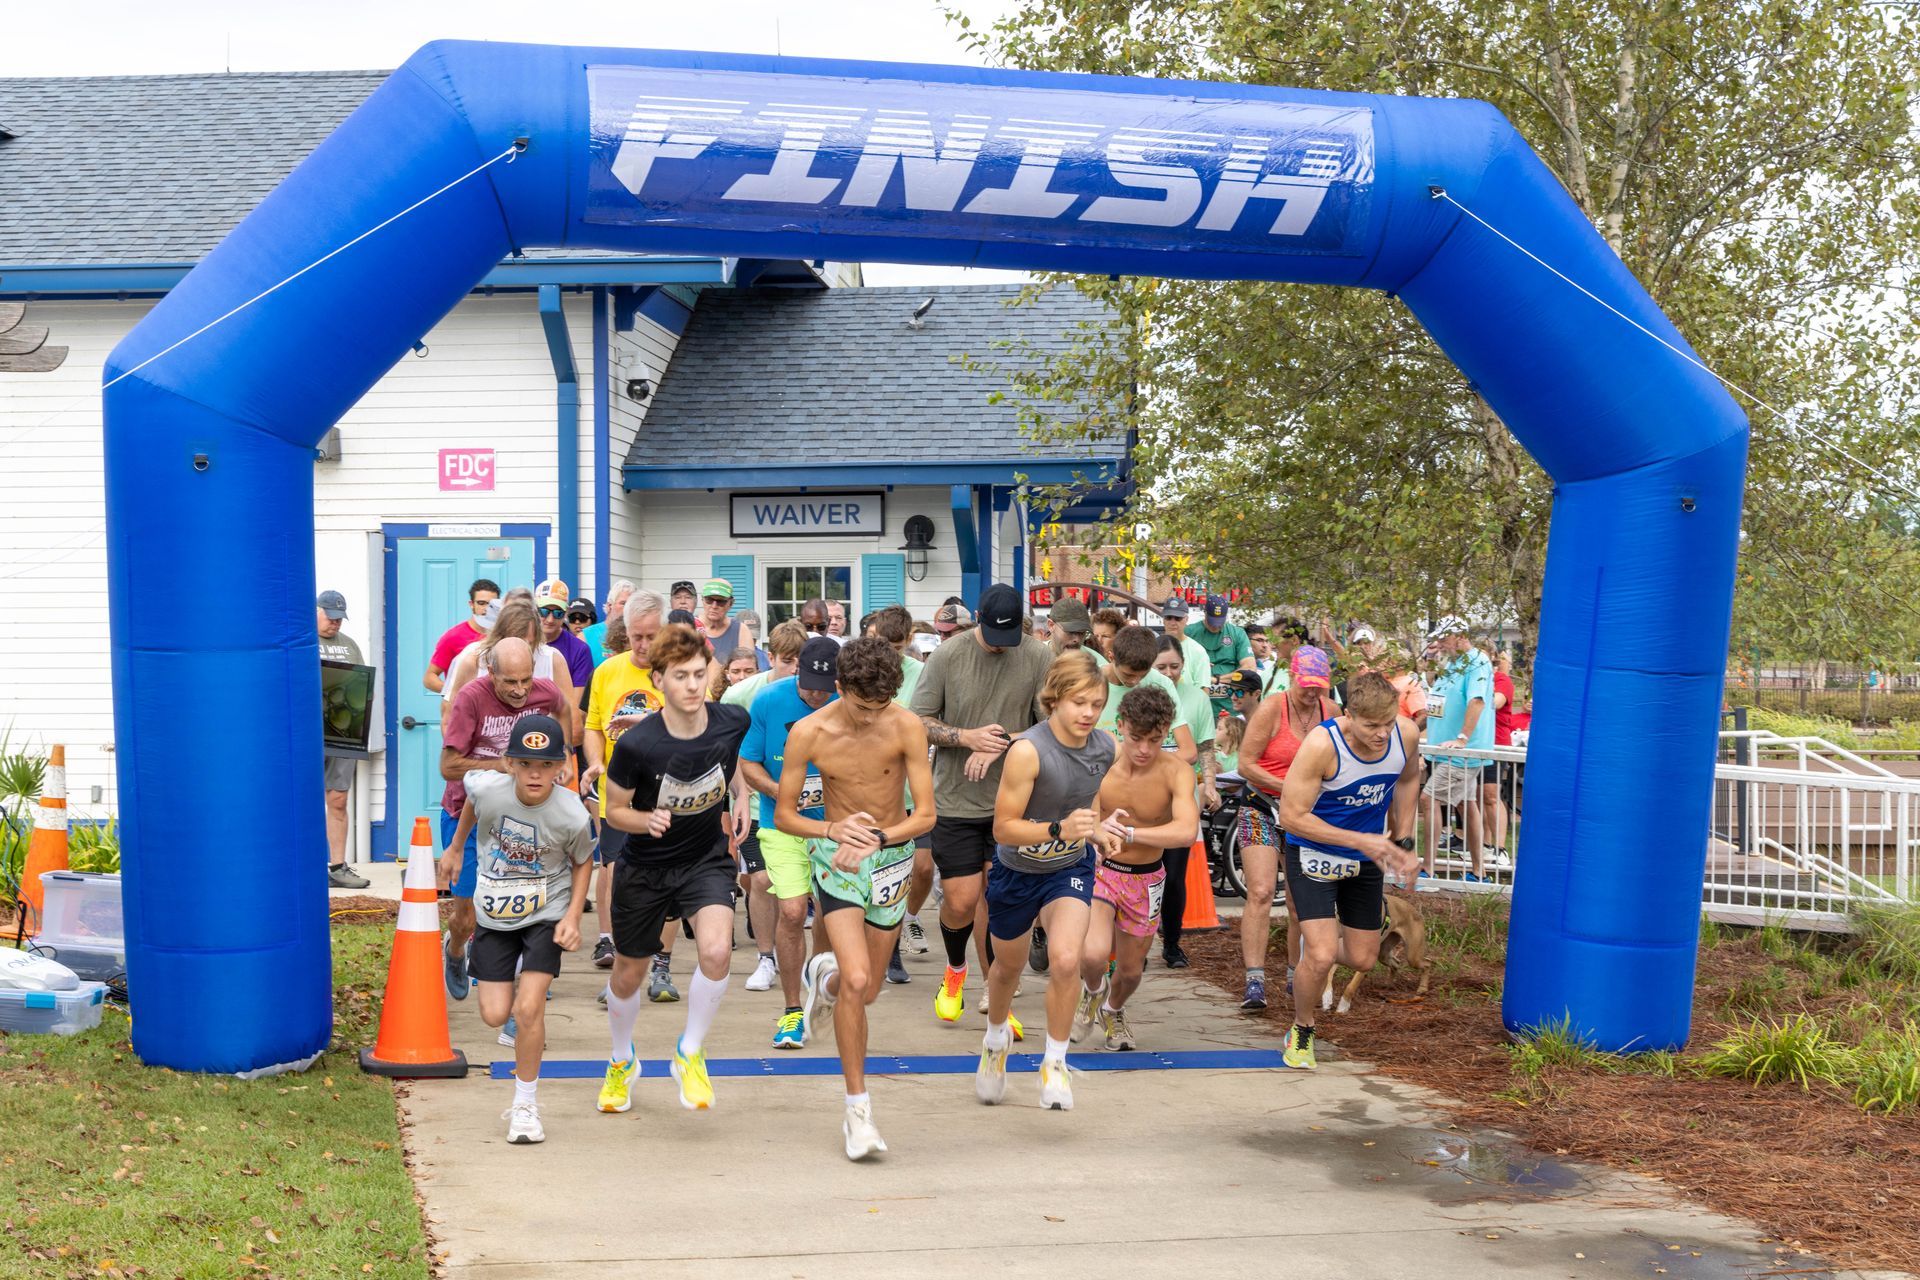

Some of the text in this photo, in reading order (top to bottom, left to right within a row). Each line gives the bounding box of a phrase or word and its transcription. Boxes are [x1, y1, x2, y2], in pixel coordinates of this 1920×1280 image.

[611, 95, 1345, 236] FINISH
[445, 453, 489, 477] FDC
[753, 503, 861, 525] WAIVER
[432, 527, 497, 535] ELECTRICAL ROOM
[1307, 859, 1356, 878] 3845
[482, 895, 540, 915] 3781
